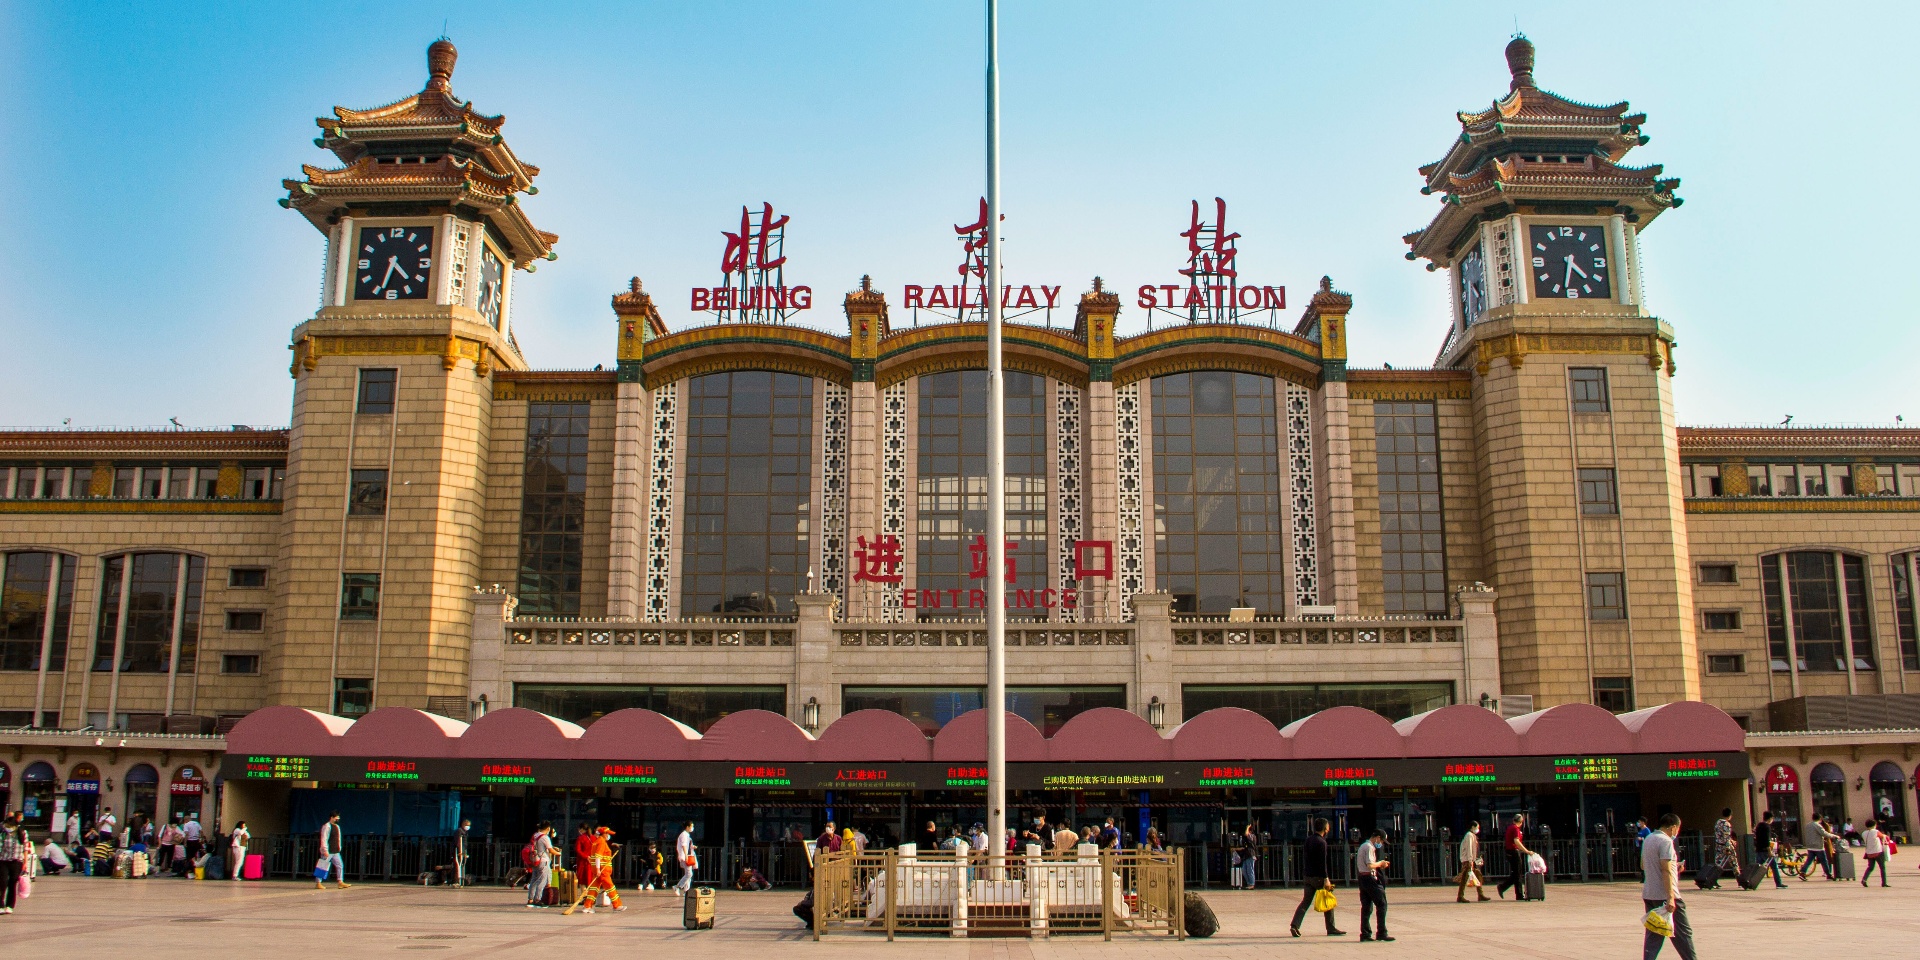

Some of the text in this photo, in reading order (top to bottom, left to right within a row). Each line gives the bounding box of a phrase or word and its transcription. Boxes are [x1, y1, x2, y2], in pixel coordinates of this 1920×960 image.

[390, 228, 405, 239] 12
[1559, 227, 1574, 237] 12
[358, 259, 371, 270] 9
[419, 258, 432, 269] 3
[1532, 257, 1545, 268] 9
[1593, 257, 1606, 268] 3
[385, 289, 398, 300] 6
[691, 285, 812, 311] BEIJING
[1137, 284, 1287, 309] STATION
[1566, 288, 1579, 299] 6
[903, 588, 1078, 609] ENTRNCE
[367, 760, 415, 771] 自助进站口
[482, 764, 531, 775] 自助进站口
[604, 764, 654, 775] 自助进站口
[1445, 763, 1494, 775] 自助进站口
[1668, 758, 1716, 770] 自助进站口
[735, 766, 786, 777] 自助进站口
[835, 769, 887, 780] 人工进站口
[1203, 767, 1253, 778] 自助进站口
[1325, 767, 1375, 779] 自助进站口
[67, 782, 98, 791] 站区寄存
[171, 783, 202, 792] 华联超市
